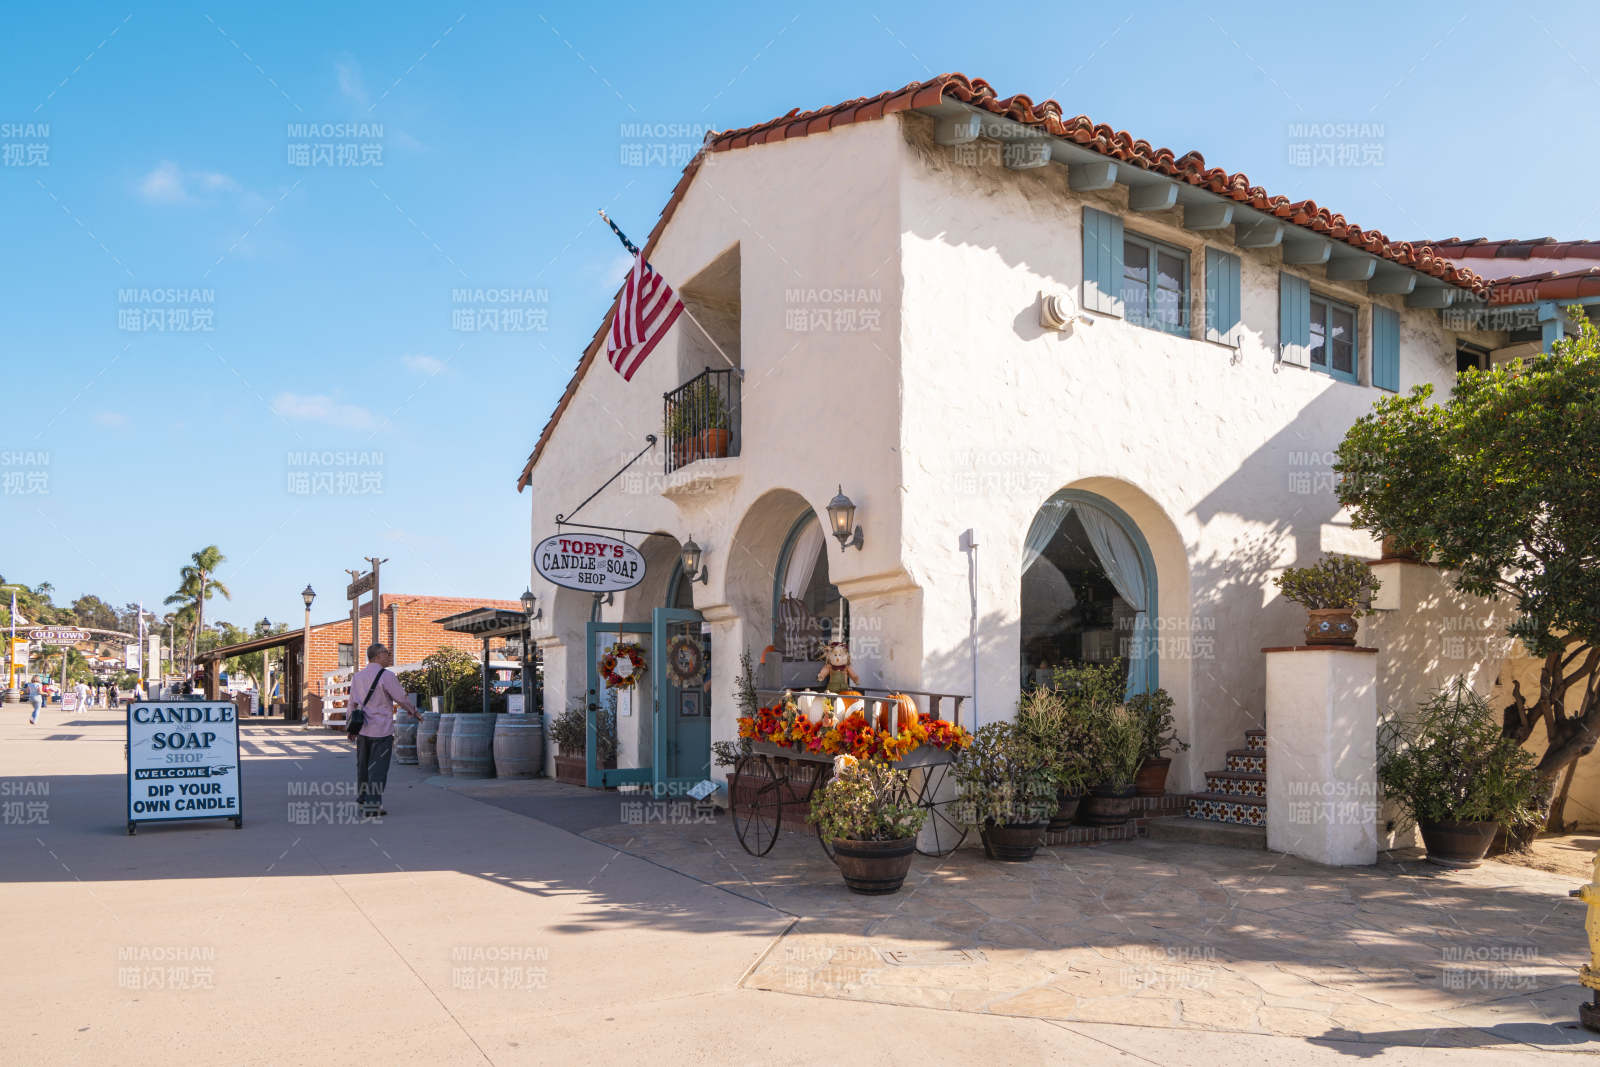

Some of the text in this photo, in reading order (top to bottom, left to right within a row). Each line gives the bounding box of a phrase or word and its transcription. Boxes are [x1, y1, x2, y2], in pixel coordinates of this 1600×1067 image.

[559, 539, 624, 558] TOBY'S
[542, 553, 596, 571] CANDLE
[607, 559, 638, 579] SOAP
[578, 572, 606, 585] SHOP
[35, 631, 85, 640] OLD TOWN
[133, 707, 234, 724] CANDLE
[152, 732, 216, 750] SOAP
[166, 753, 204, 764] SHOP
[138, 769, 206, 778] WELCOME
[148, 783, 221, 797] DIP YOUR
[133, 797, 236, 814] OWN CANDLE
